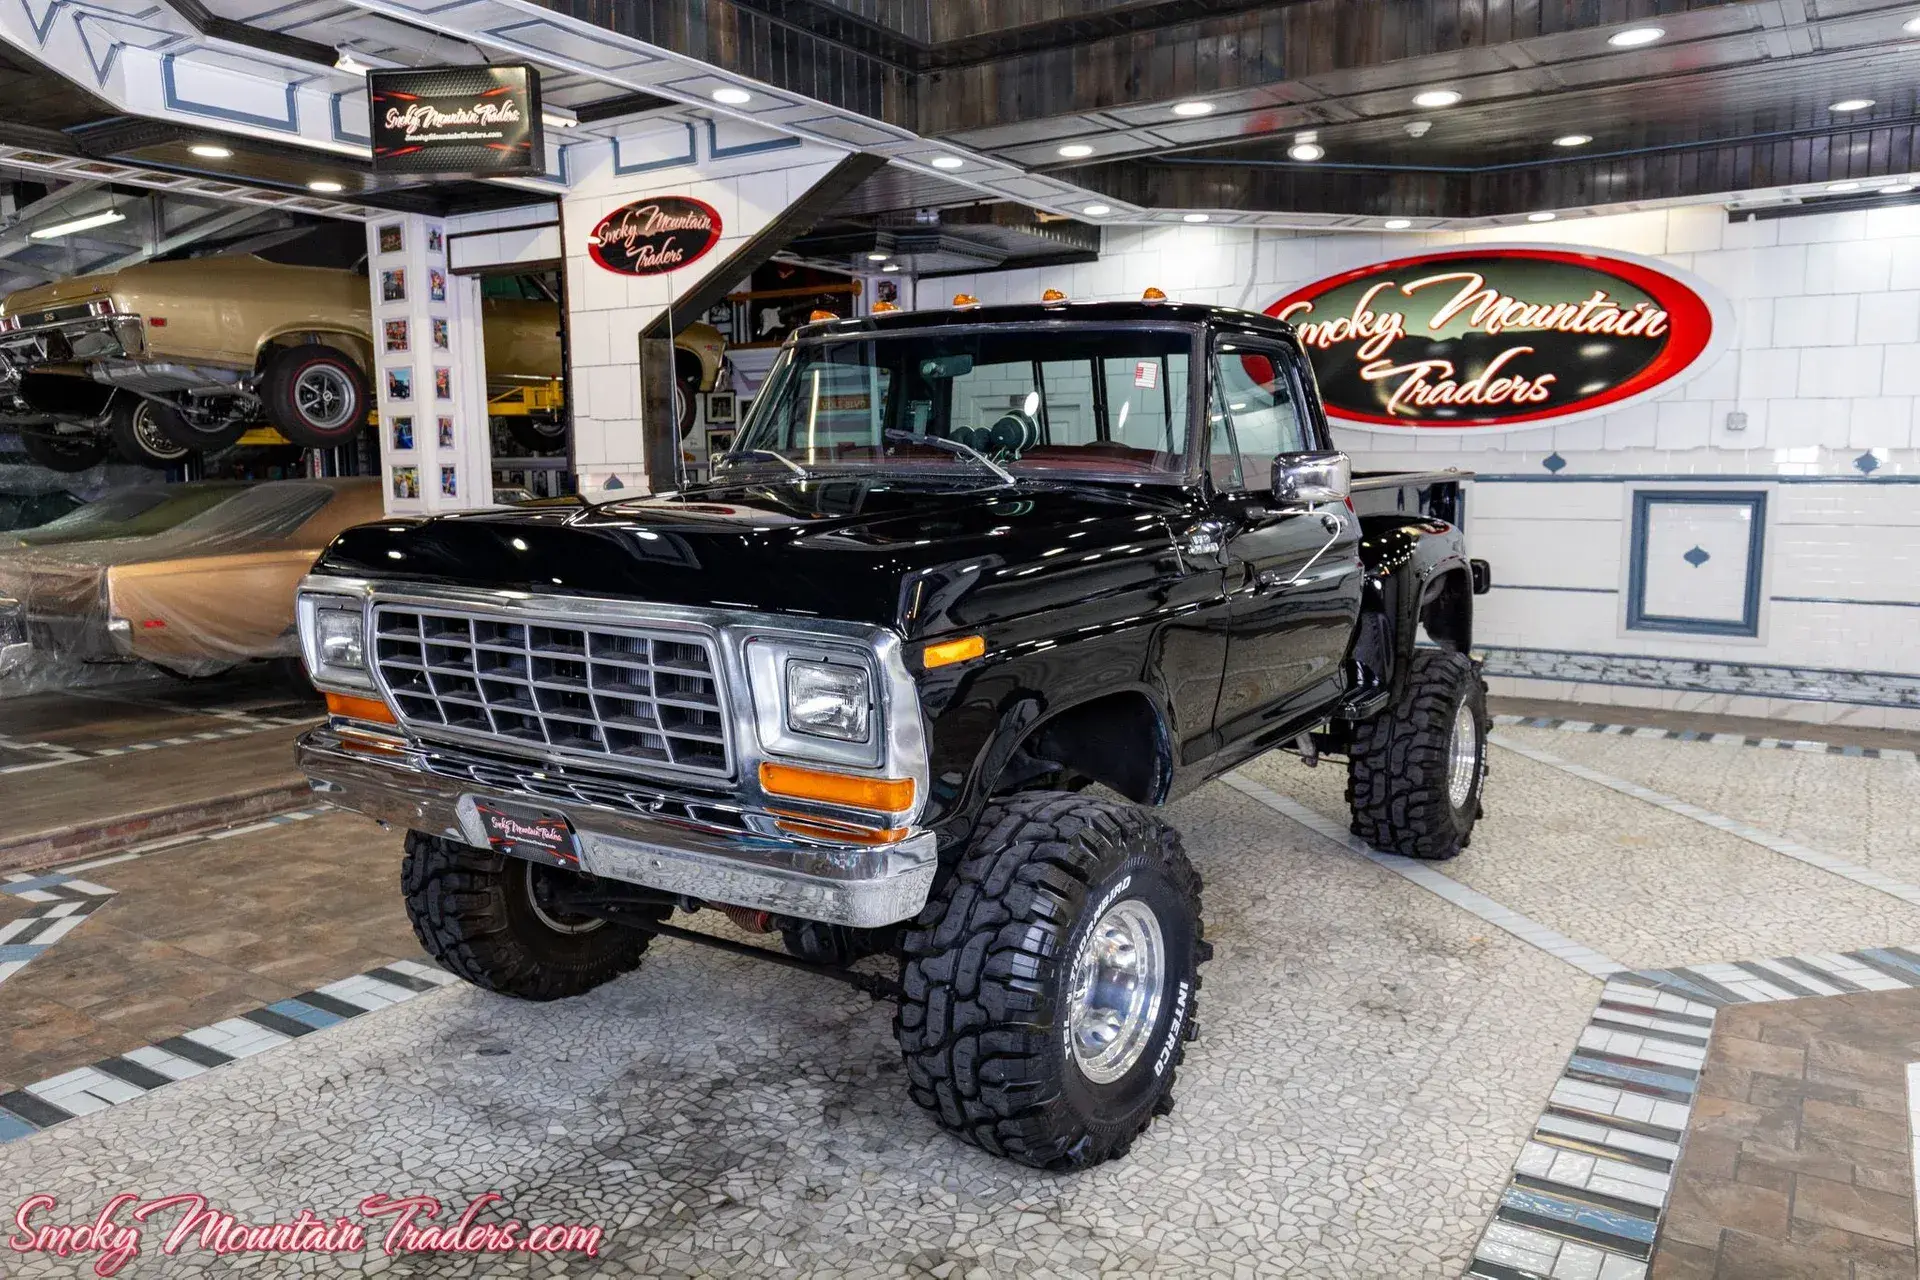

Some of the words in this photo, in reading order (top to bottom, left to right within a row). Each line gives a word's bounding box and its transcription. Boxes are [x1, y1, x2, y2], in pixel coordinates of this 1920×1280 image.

[385, 104, 420, 134] Smoky
[416, 105, 479, 128] Mountain
[474, 100, 520, 126] Traders
[598, 211, 638, 249] Smoky
[636, 205, 711, 231] Mountain
[626, 236, 683, 272] Traders
[44, 313, 54, 321] SS
[1401, 272, 1669, 338] Mountain
[1361, 346, 1556, 416] Traders
[1069, 875, 1131, 982] THORNBIRD
[1154, 981, 1188, 1077] INTERCO
